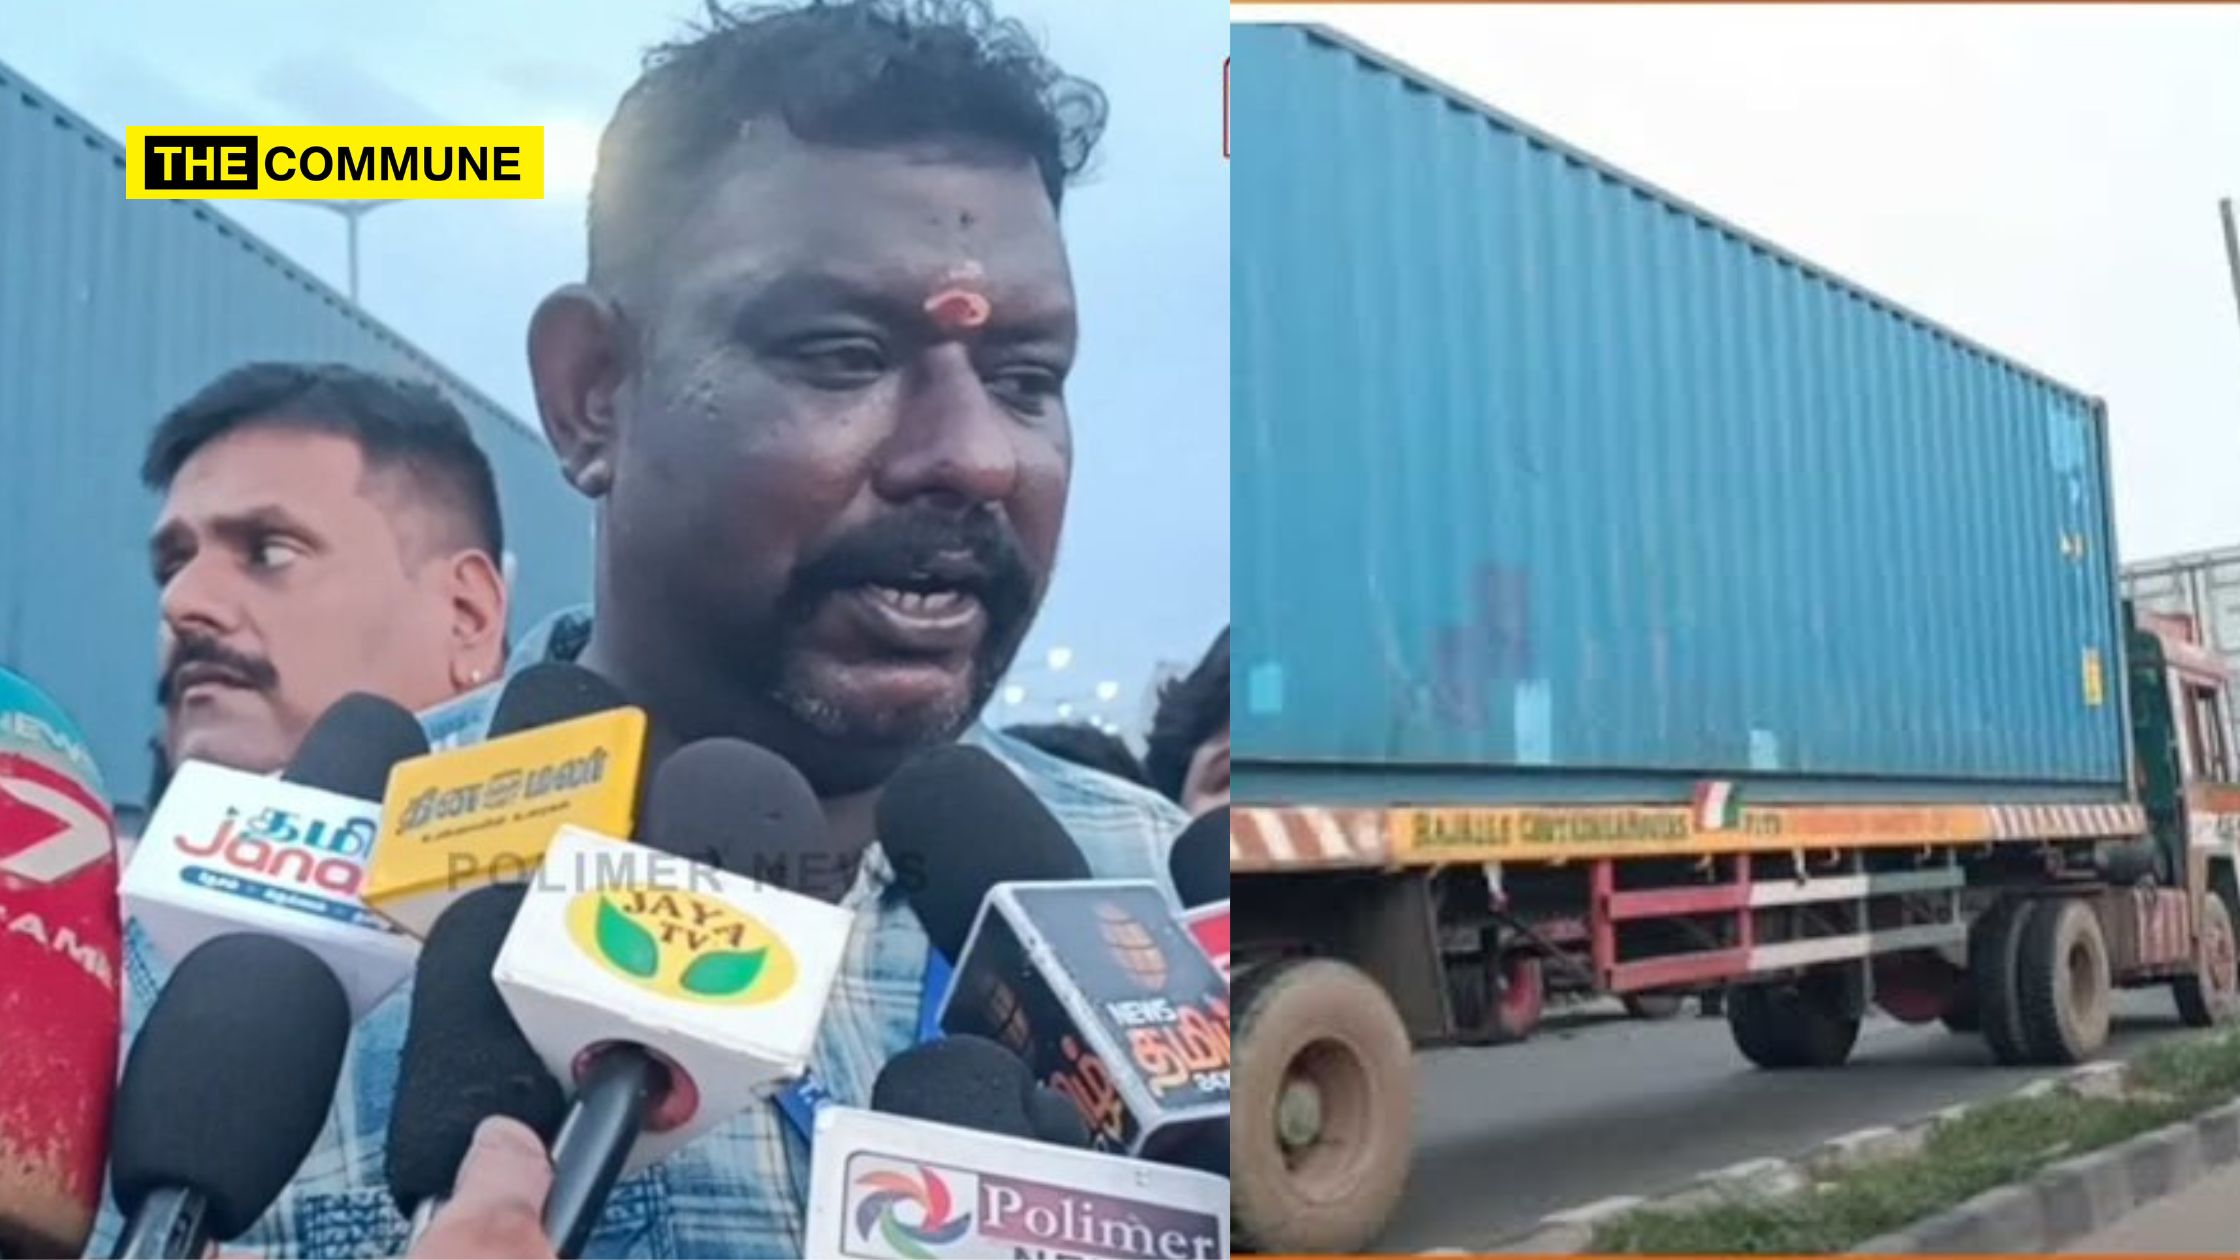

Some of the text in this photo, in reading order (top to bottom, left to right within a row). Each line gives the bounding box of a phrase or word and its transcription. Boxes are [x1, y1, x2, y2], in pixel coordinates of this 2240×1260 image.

[174, 806, 364, 896] Jana
[237, 806, 377, 859] தமி
[983, 1183, 1215, 1260] Polimer
